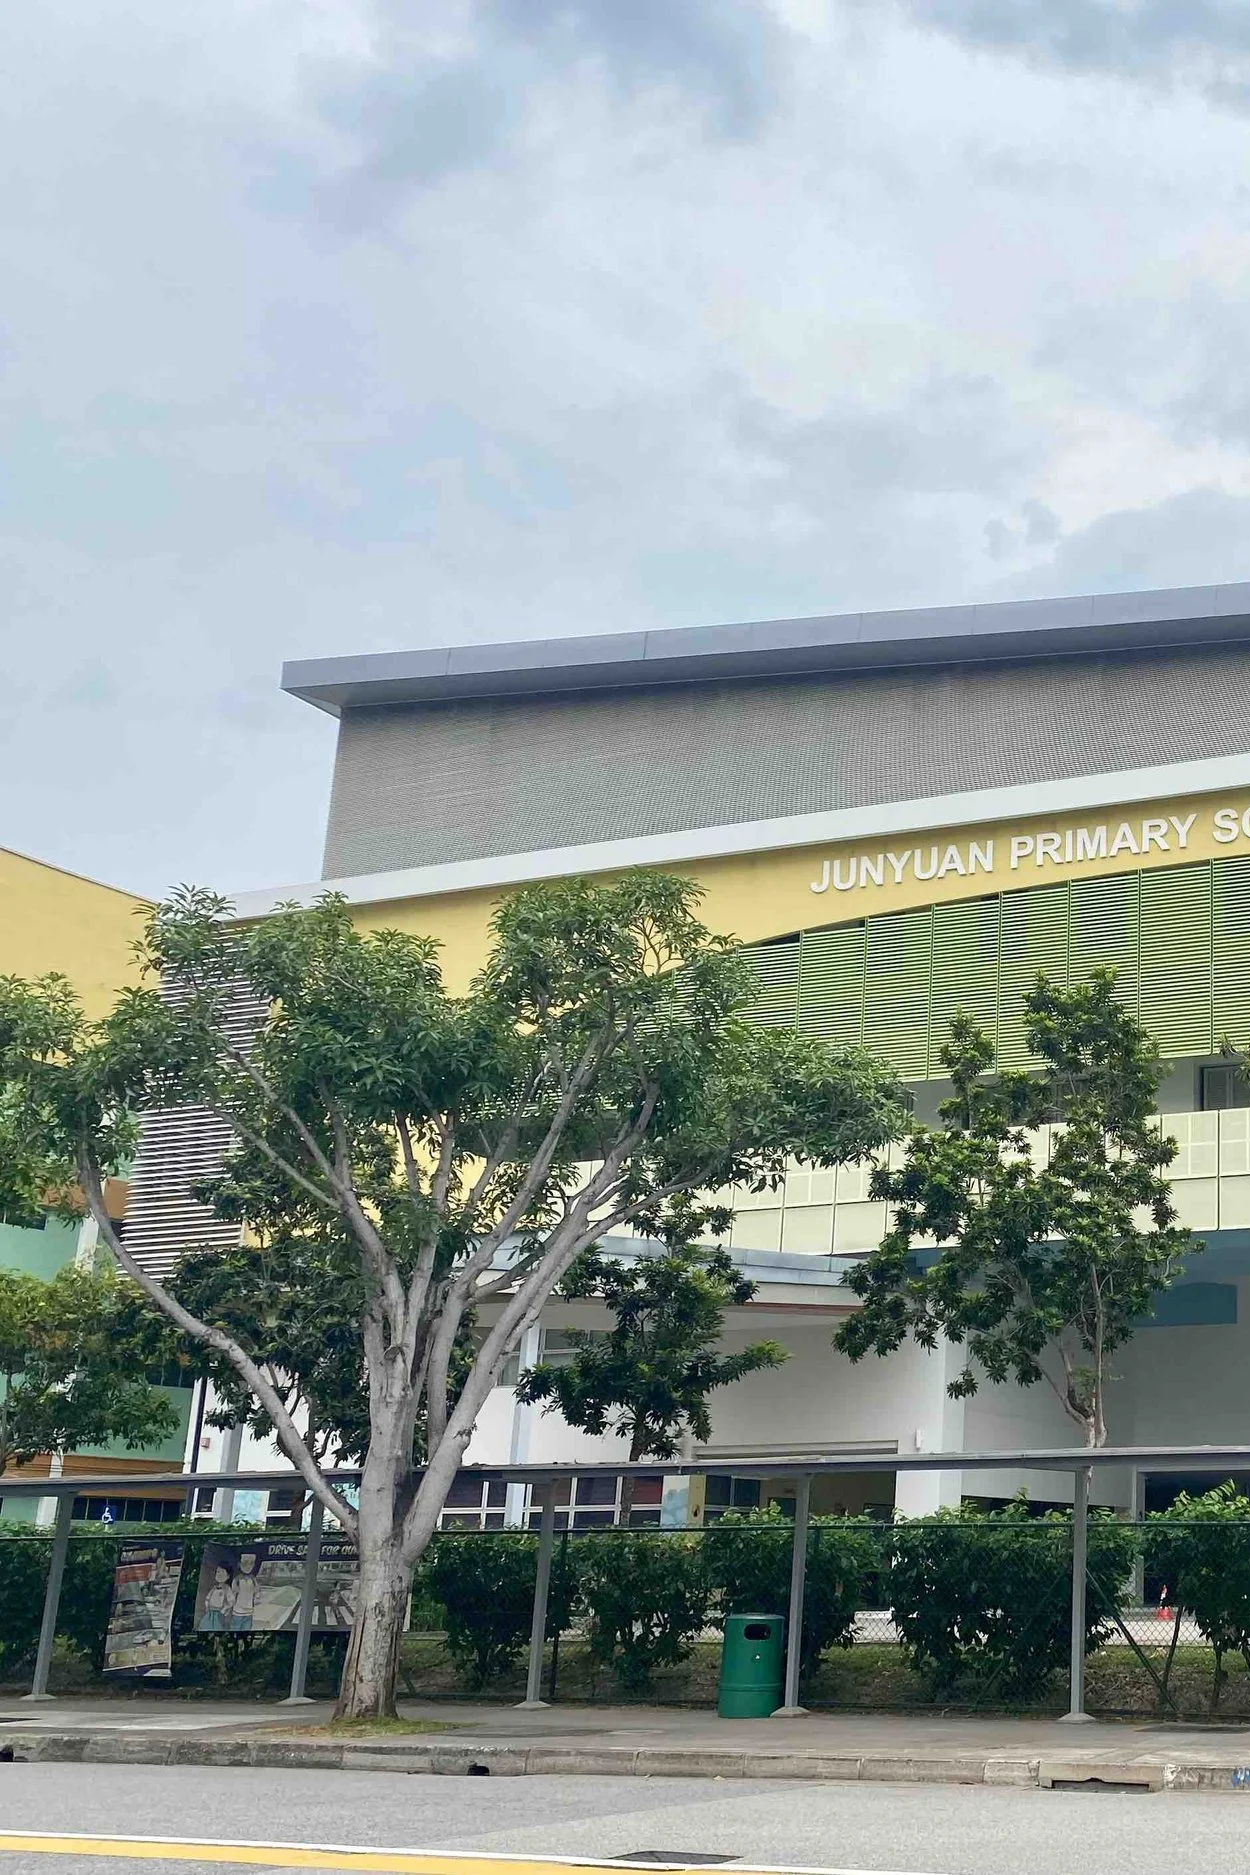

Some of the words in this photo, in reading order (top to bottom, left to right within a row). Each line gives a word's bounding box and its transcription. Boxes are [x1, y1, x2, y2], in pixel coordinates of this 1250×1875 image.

[810, 840, 994, 893] JUNYUAN
[1010, 813, 1197, 869] PRIMARY
[268, 1544, 295, 1556] DRIVE
[321, 1544, 340, 1556] FOR
